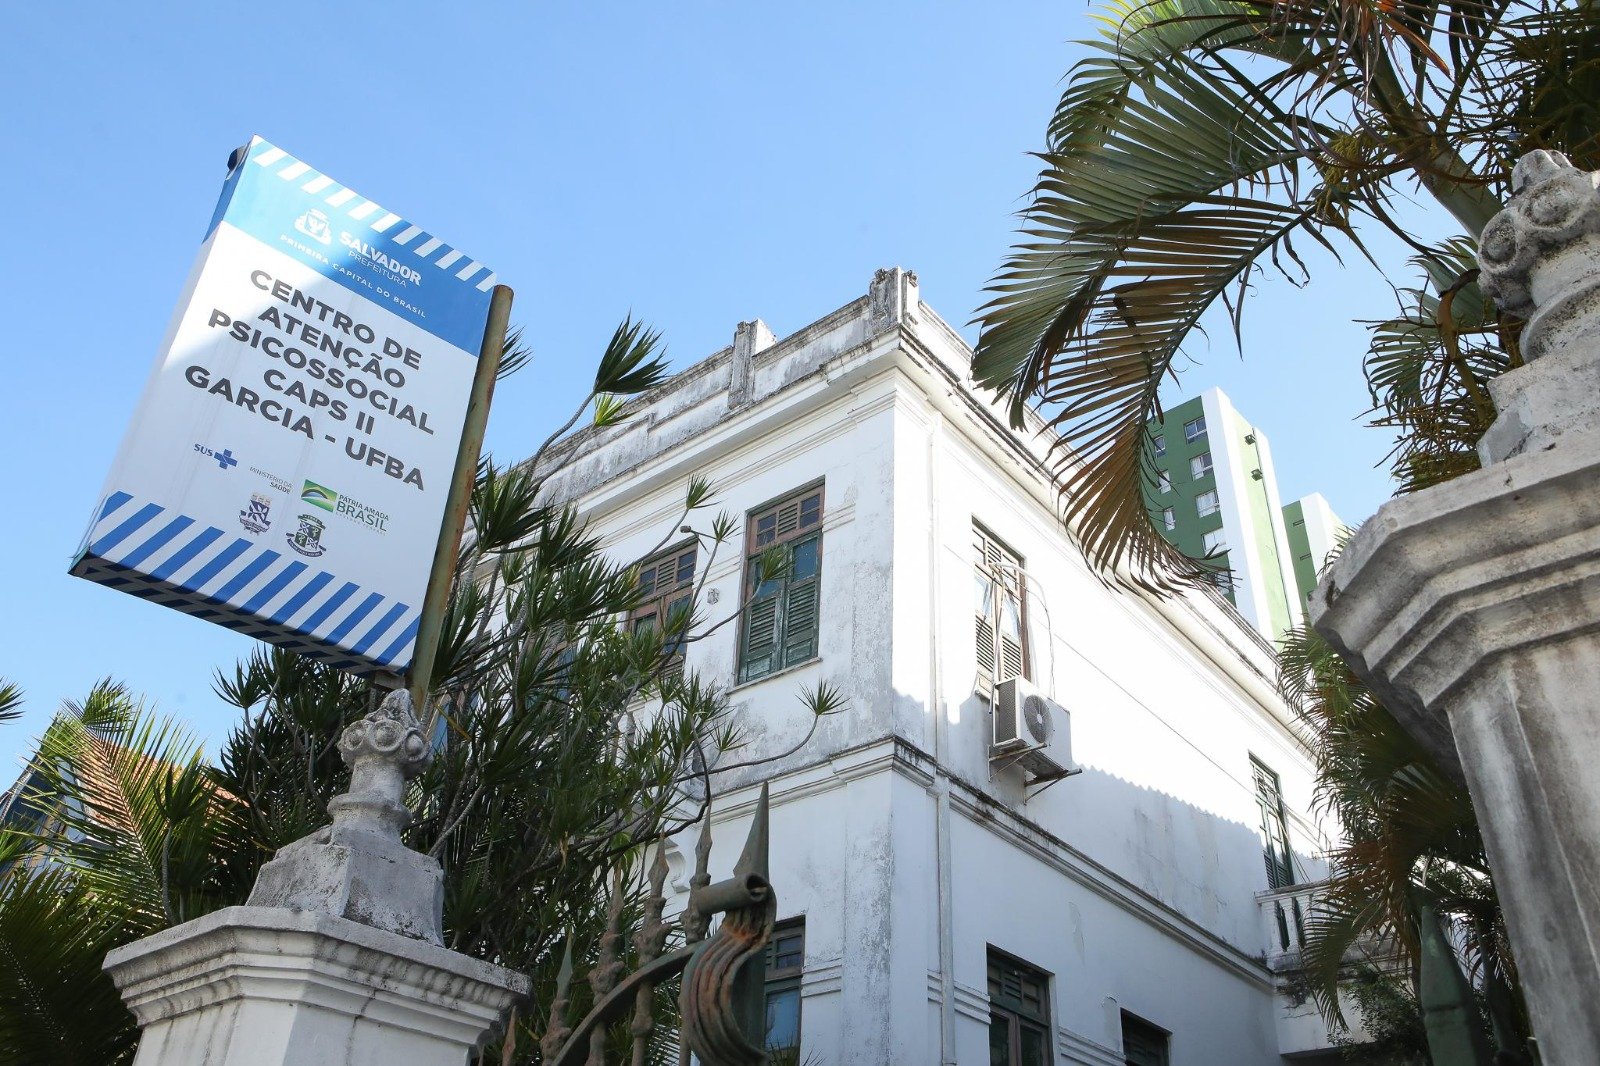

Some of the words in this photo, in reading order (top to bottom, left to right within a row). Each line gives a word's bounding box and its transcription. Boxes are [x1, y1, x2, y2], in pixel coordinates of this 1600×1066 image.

[280, 234, 329, 265] PRIMEIRA
[333, 263, 373, 289] CAPITAL
[376, 286, 390, 298] DO
[393, 297, 426, 318] BRASIL
[339, 231, 422, 287] SALVADOR
[349, 250, 407, 288] PREFEITURA
[250, 269, 376, 344] CENTRO
[382, 337, 422, 371] DE
[258, 306, 406, 389] ATENÇÃO
[207, 308, 435, 435] PSICOSSOCIAL
[263, 369, 347, 421] CAPS
[355, 411, 375, 435] II
[184, 365, 314, 440] GARCIA
[324, 434, 336, 443] -
[345, 436, 425, 491] UFBA
[193, 443, 213, 457] SUS
[336, 500, 387, 532] BRASIL
[339, 494, 363, 510] PÁTRIA
[363, 506, 389, 521] AMADA
